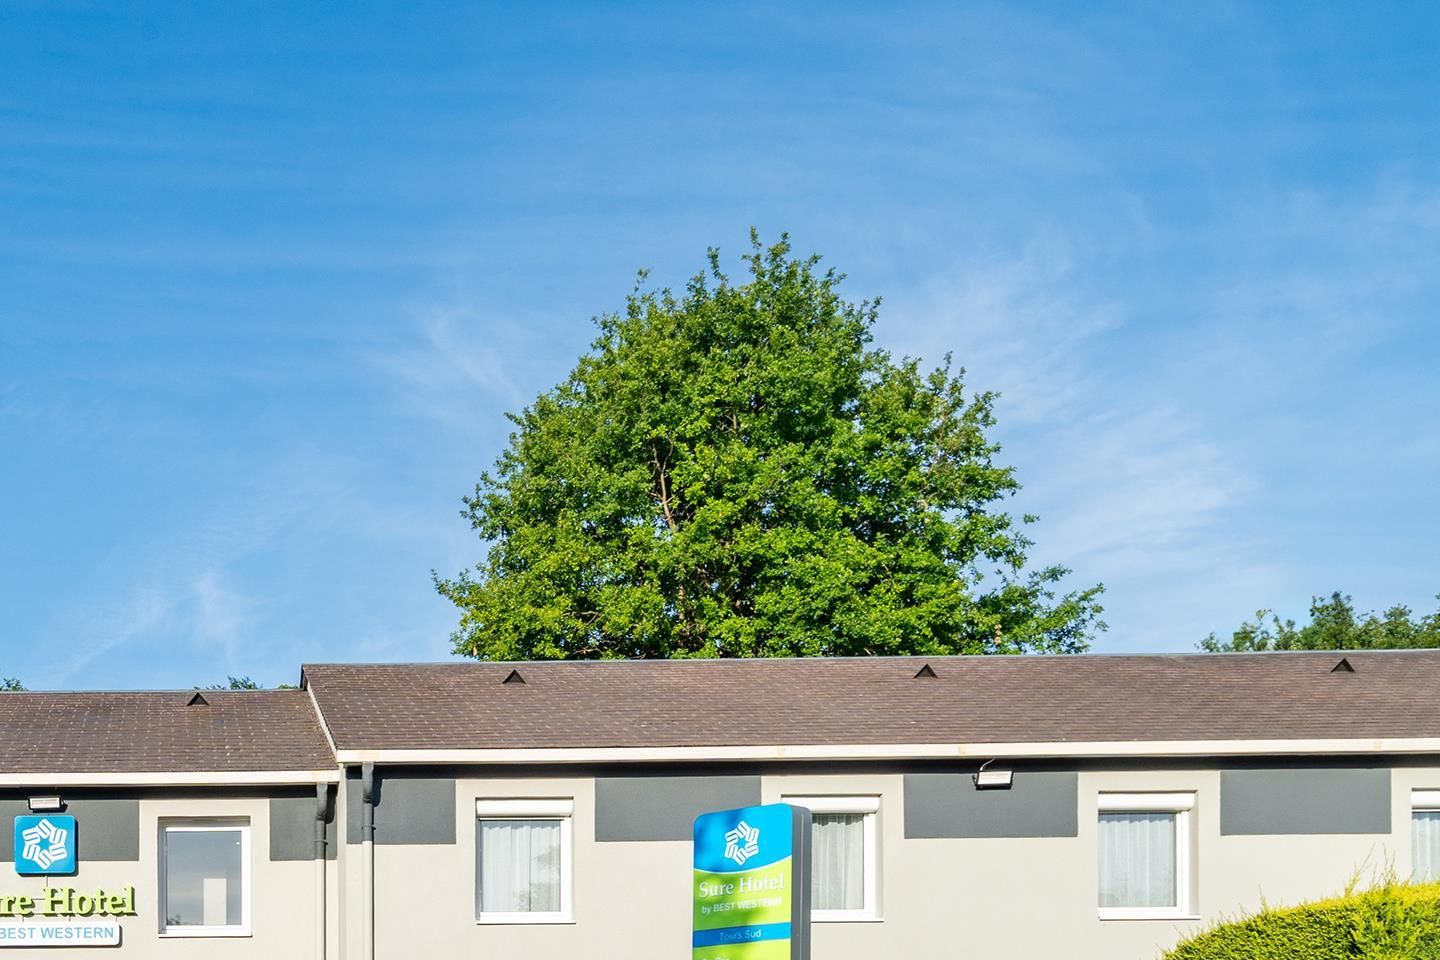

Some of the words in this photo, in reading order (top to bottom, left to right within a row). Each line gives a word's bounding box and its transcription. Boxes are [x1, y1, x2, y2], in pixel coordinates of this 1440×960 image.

[698, 881, 735, 898] Sure
[739, 872, 785, 894] Hotel
[40, 885, 137, 917] Hotel
[701, 905, 711, 915] by
[713, 902, 735, 912] BEST
[40, 926, 114, 939] WESTERN
[719, 931, 743, 940] Tours
[744, 929, 762, 938] Sud
